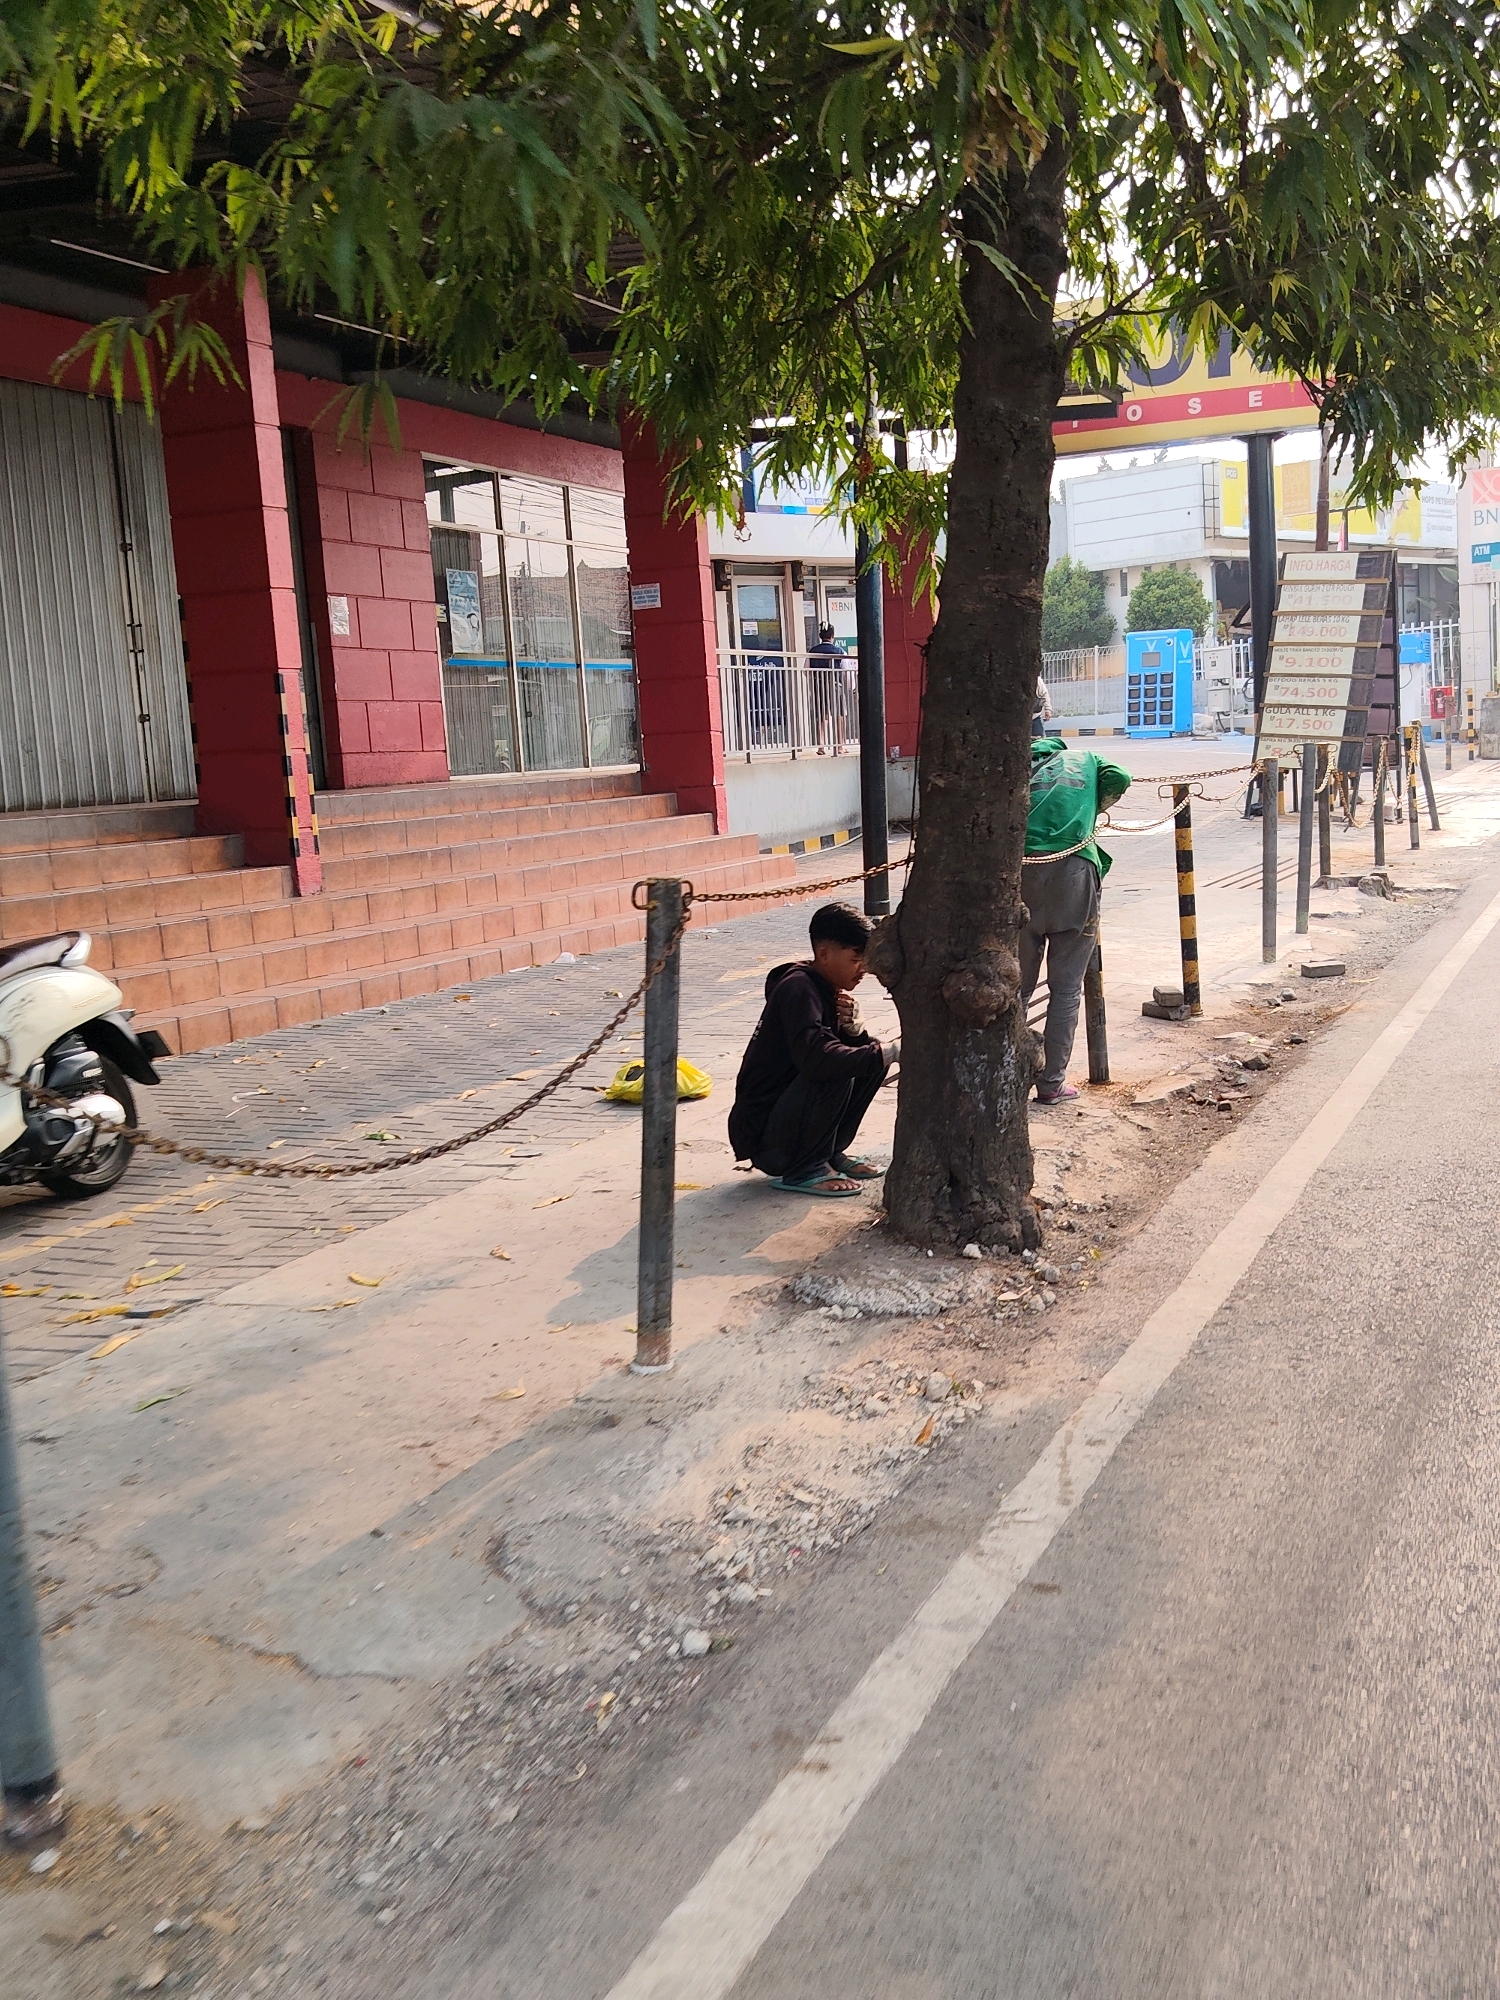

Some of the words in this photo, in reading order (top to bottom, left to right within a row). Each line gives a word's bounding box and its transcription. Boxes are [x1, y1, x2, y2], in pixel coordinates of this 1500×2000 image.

[1474, 545, 1490, 556] ATM
[1289, 560, 1313, 571] INFO
[1316, 560, 1351, 571] HARGA
[838, 602, 853, 611] BNI
[1288, 626, 1347, 637] 149.000
[1285, 656, 1342, 667] 9.100
[1280, 686, 1338, 698] 74.500
[1265, 706, 1292, 715] GULA
[1294, 707, 1311, 716] ALL
[1314, 708, 1319, 716] 1
[1322, 709, 1336, 717] KG
[1275, 718, 1333, 731] 17.500
